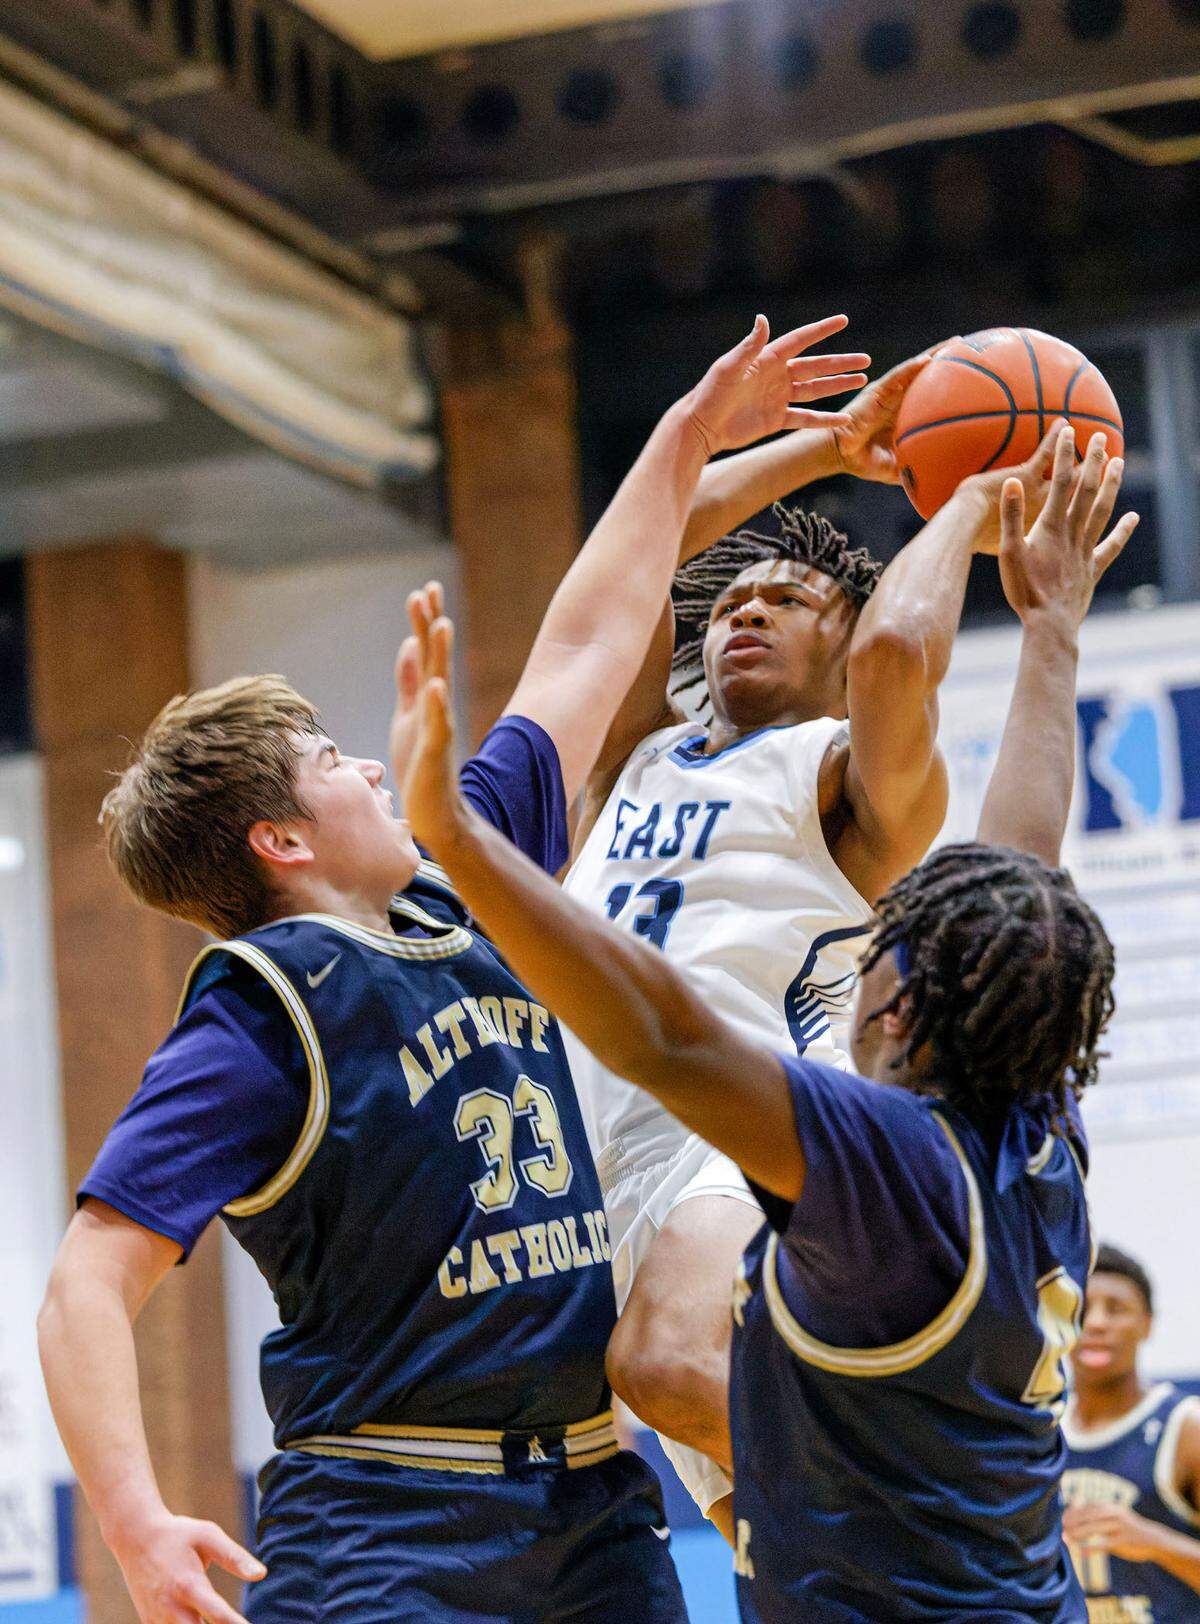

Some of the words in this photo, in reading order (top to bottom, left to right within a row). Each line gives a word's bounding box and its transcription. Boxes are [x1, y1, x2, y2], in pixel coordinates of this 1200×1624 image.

[606, 799, 733, 861] EAST
[398, 996, 550, 1108] ALTHOFF
[453, 1074, 574, 1215] 33
[437, 1210, 612, 1298] CATHOLIC
